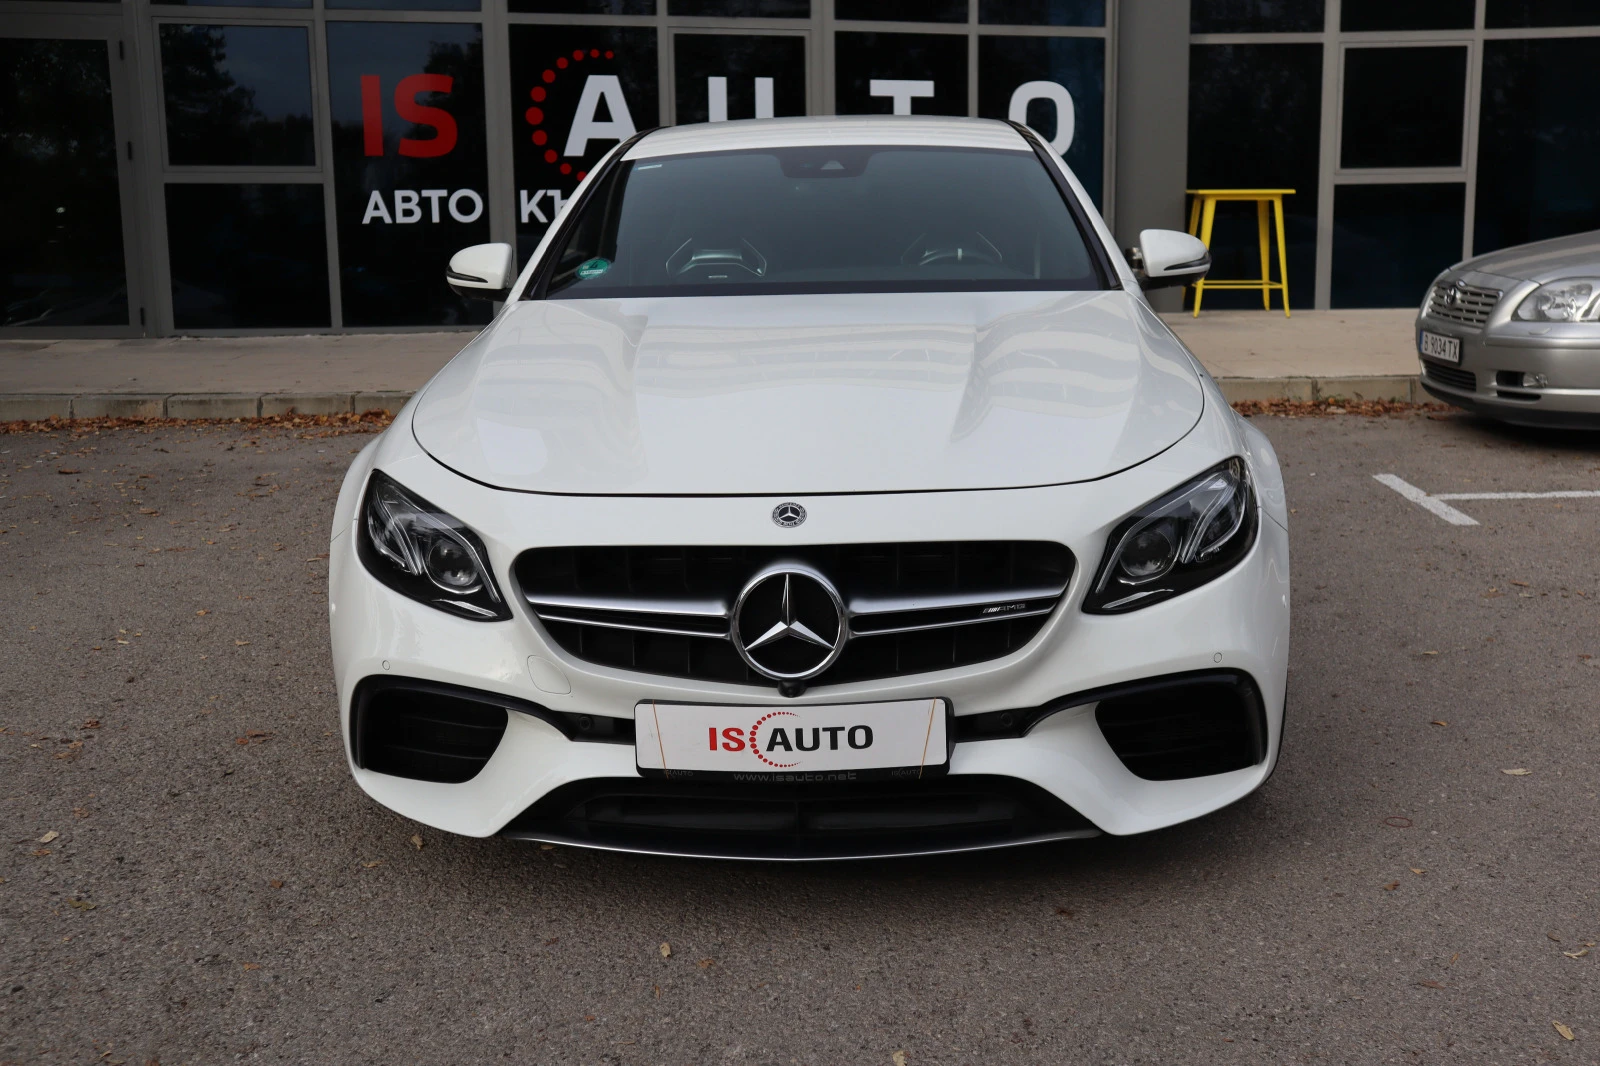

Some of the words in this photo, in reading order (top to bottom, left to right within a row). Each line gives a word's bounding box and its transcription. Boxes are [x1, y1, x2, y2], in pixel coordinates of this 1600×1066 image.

[361, 73, 458, 158] IS
[362, 188, 483, 224] АВТО
[708, 727, 746, 752] IS
[765, 725, 874, 752] AUTO
[733, 771, 857, 782] www.isauto.net
